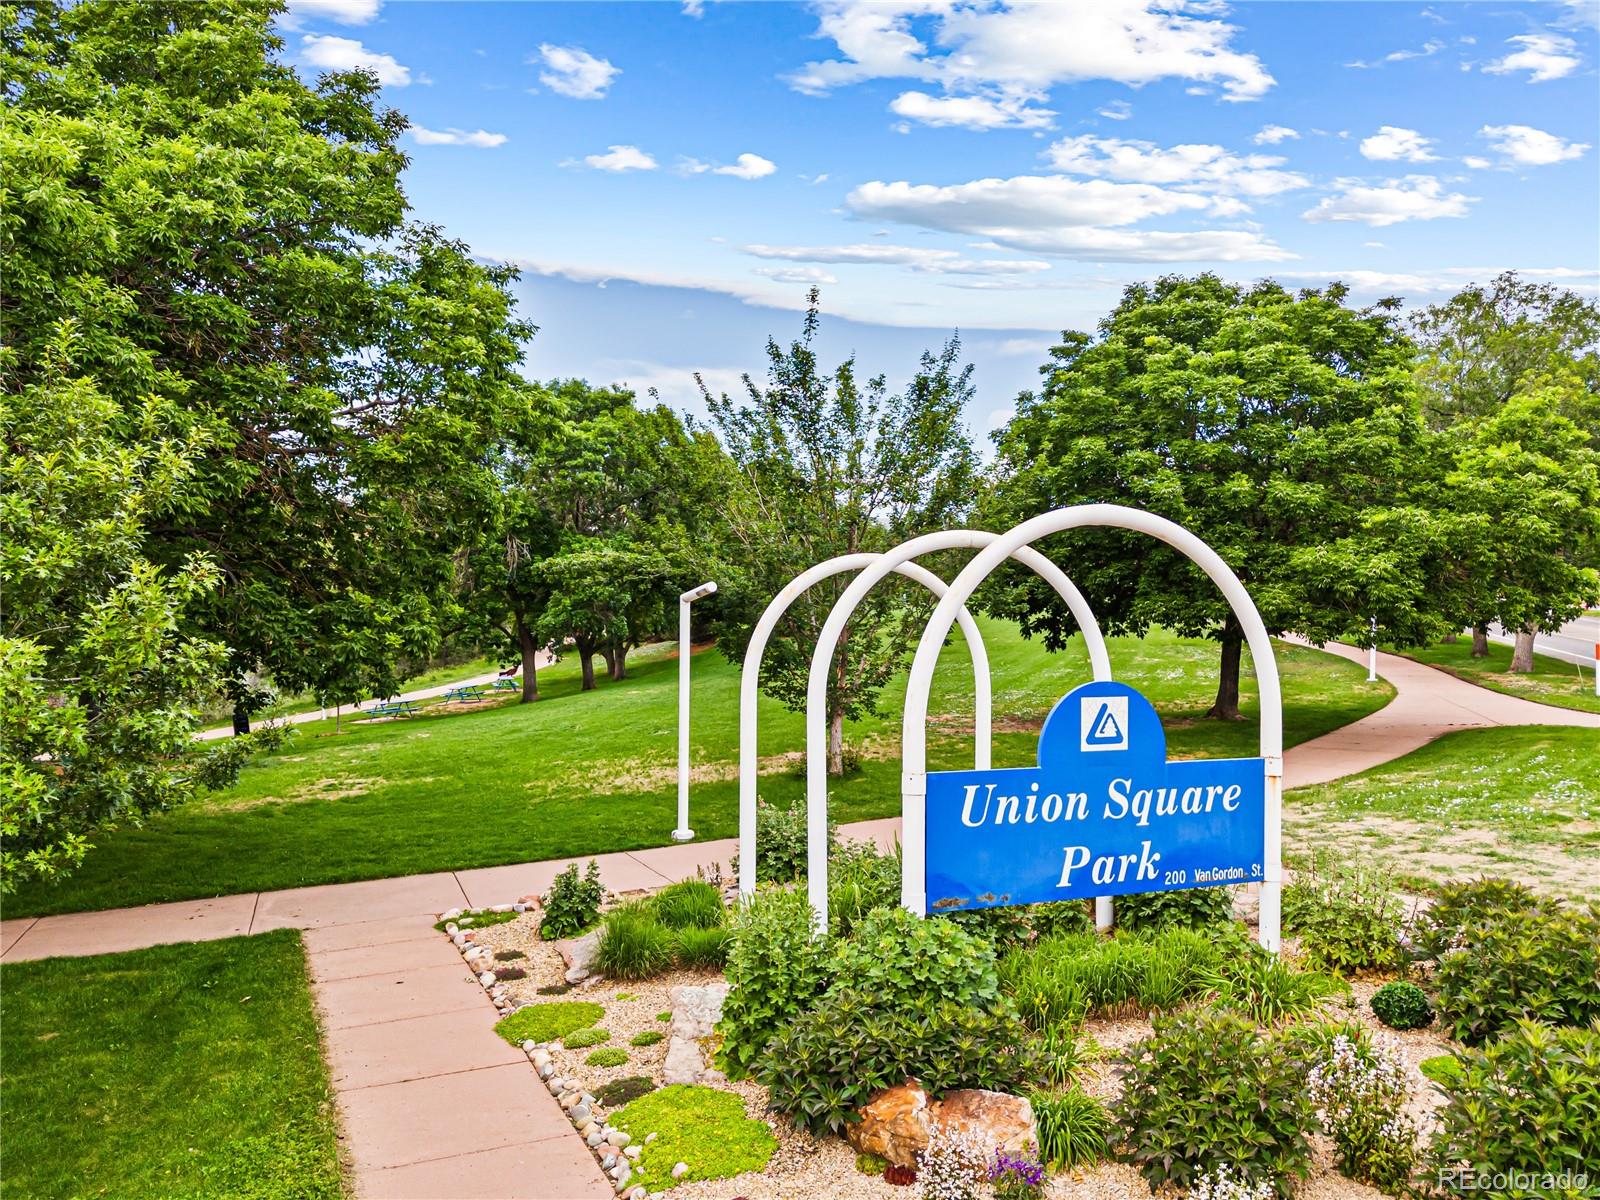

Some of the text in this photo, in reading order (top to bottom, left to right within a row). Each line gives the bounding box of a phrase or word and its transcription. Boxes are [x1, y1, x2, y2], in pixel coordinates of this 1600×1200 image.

[960, 778, 1242, 827] Union Square
[1056, 840, 1161, 888] Park
[1164, 863, 1264, 885] 200 Van Gordon St.
